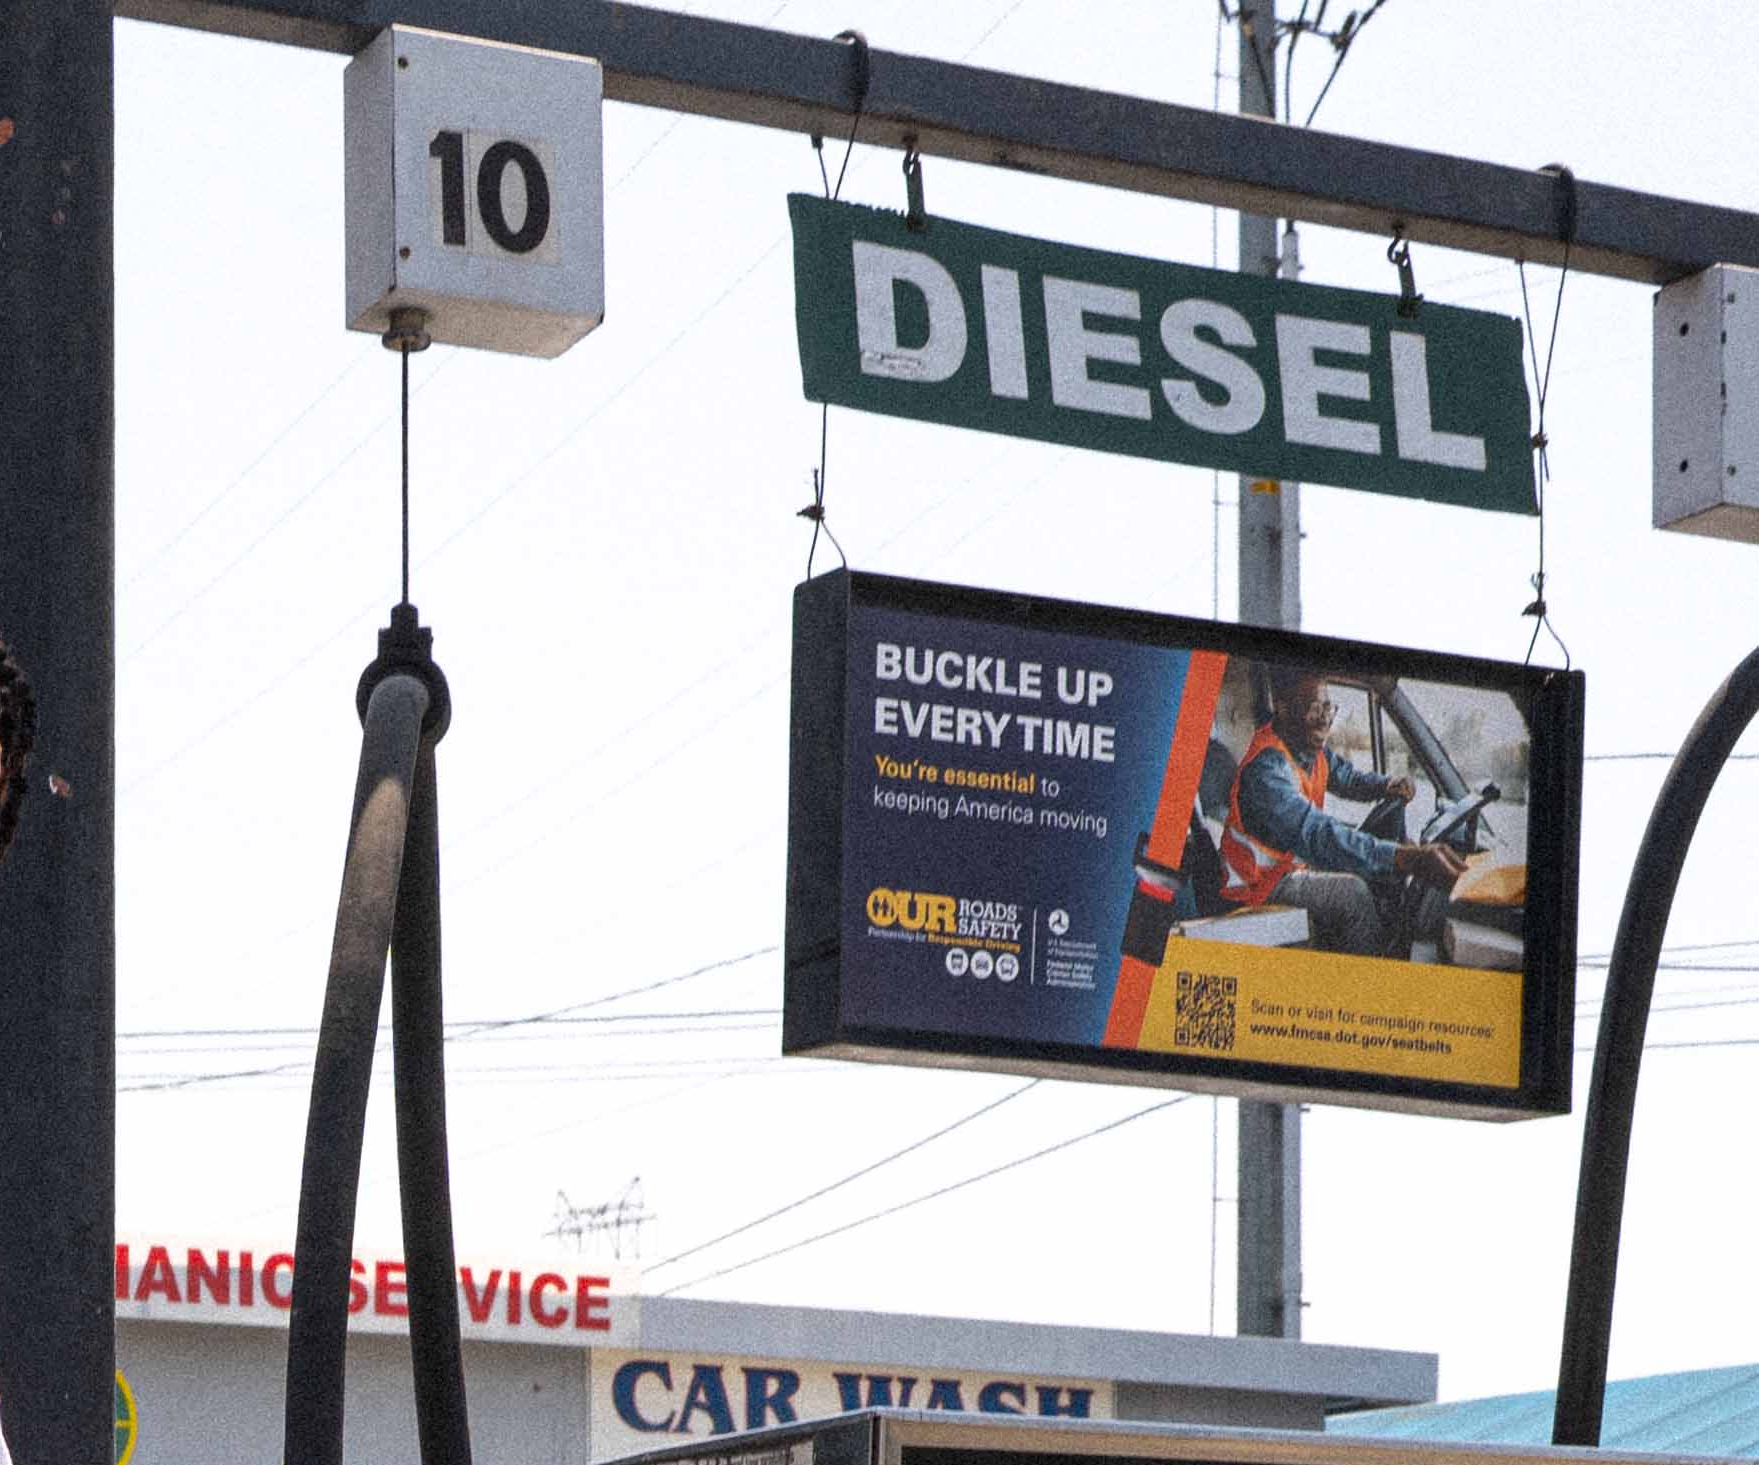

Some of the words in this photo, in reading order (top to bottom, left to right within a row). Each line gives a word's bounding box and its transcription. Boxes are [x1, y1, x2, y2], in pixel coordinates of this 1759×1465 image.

[429, 130, 551, 254] 10
[851, 238, 1488, 472] DIESEL
[875, 642, 1043, 699] BUCKLE
[1056, 667, 1114, 707] UP
[874, 696, 1011, 749] EVERY
[1016, 714, 1116, 763] TIME
[874, 754, 938, 783] You're
[943, 768, 1035, 795] essential
[1041, 778, 1060, 798] to
[873, 784, 949, 819] keeping
[954, 795, 1034, 825] America
[1040, 810, 1108, 838] moving
[866, 886, 958, 933] OUR
[958, 897, 1018, 922] ROADS
[958, 918, 1022, 941] SAFETY
[1250, 998, 1284, 1017] Scan
[1288, 1006, 1302, 1018] or
[1306, 1007, 1334, 1022] visit
[1338, 1009, 1355, 1024] for
[1360, 1014, 1425, 1033] campaign
[115, 1243, 298, 1310] ANIC
[611, 1360, 803, 1435] CAR
